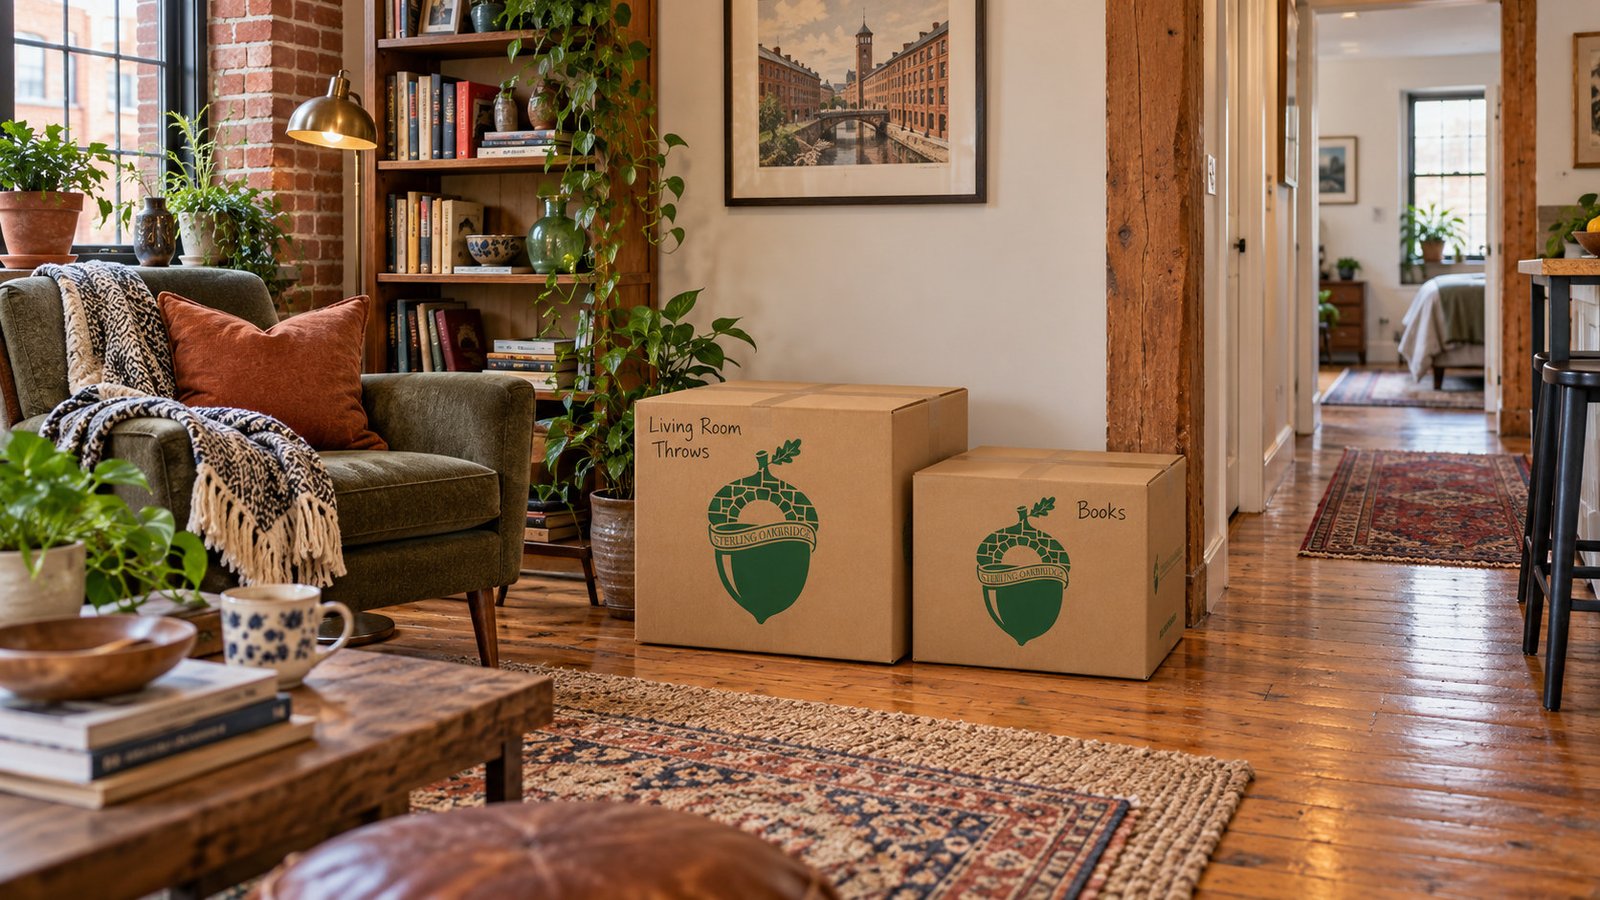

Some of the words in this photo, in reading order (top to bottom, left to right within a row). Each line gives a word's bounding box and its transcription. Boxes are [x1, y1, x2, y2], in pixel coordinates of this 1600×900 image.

[649, 416, 694, 442] Living
[700, 417, 742, 436] Room
[651, 440, 710, 459] Throws
[1077, 500, 1126, 520] Books
[714, 531, 757, 546] STERLING
